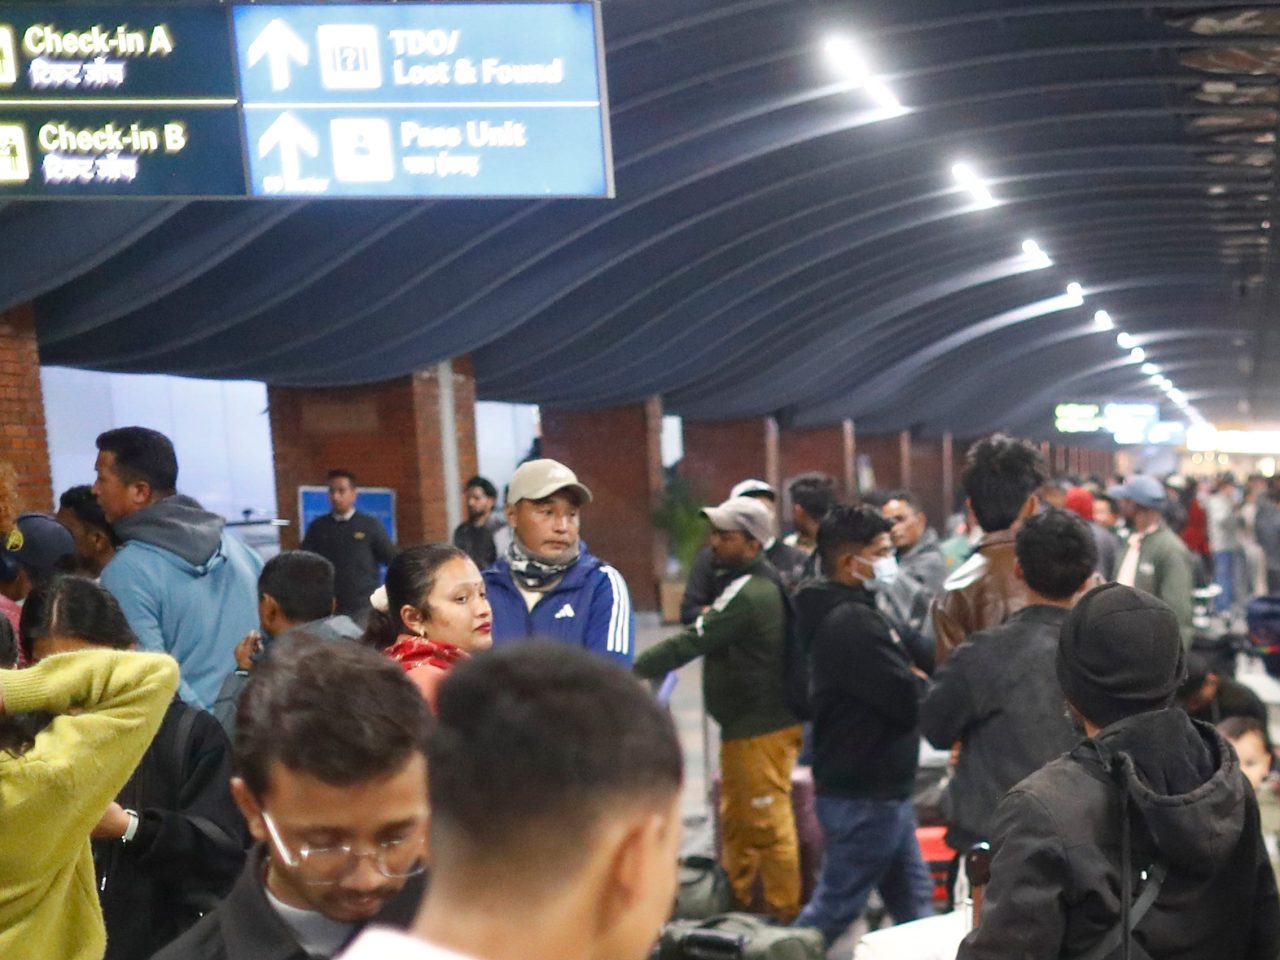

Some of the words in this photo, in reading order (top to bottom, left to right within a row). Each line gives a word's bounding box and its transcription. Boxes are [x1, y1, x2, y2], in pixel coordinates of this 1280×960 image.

[24, 26, 145, 55] Check-in
[150, 25, 173, 54] A
[389, 29, 459, 56] TDO/
[393, 59, 450, 84] Lost
[455, 58, 478, 84] &
[482, 58, 564, 84] Found
[38, 123, 158, 152] Check-in
[164, 123, 187, 151] B
[467, 121, 528, 147] Unit
